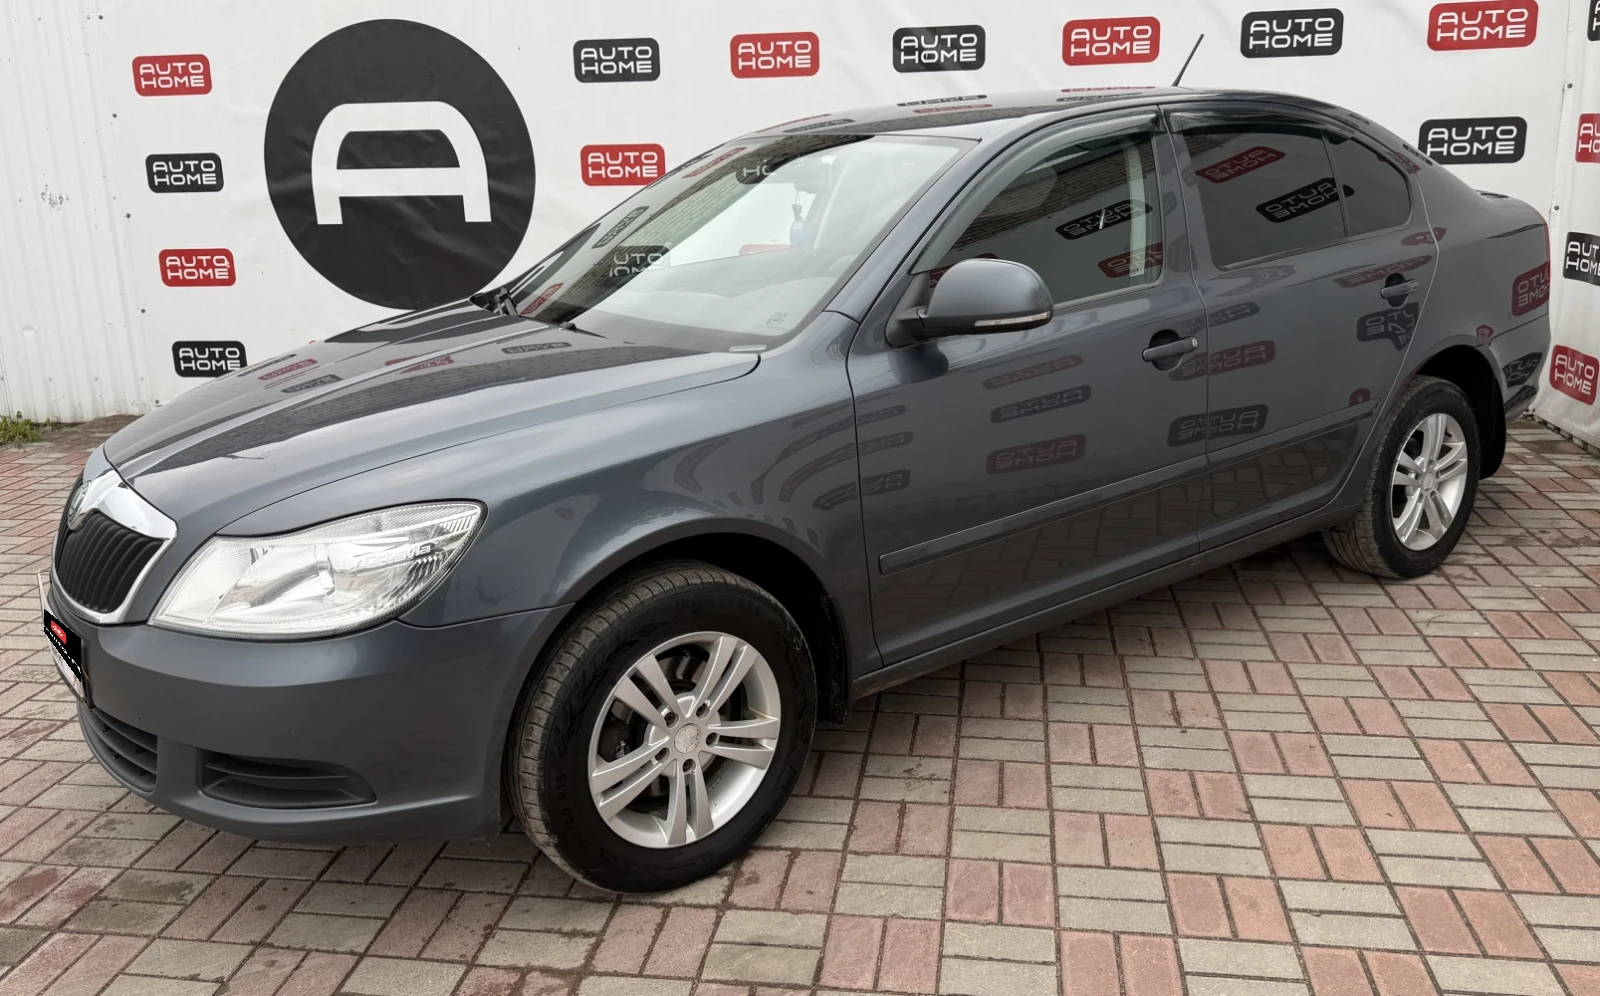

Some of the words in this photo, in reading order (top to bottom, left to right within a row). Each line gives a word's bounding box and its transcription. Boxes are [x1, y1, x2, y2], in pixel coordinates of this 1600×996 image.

[1438, 8, 1529, 26] AUTO
[1249, 17, 1335, 34] AUTO
[1436, 24, 1527, 42] HOME
[1070, 25, 1152, 42] AUTO
[737, 40, 812, 56] AUTO
[900, 33, 978, 50] AUTO
[1070, 40, 1151, 58] HOME
[1248, 33, 1334, 50] HOME
[580, 46, 653, 61] AUTO
[900, 48, 977, 65] HOME
[139, 62, 204, 75] AUTO
[581, 60, 653, 75] HOME
[738, 54, 812, 70] HOME
[140, 75, 205, 89] HOME
[1428, 125, 1518, 142] AUTO
[1426, 141, 1515, 156] HOME
[587, 151, 658, 165] AUTO
[152, 160, 216, 173] AUTO
[588, 165, 659, 179] HOME
[153, 173, 217, 186] HOME
[165, 255, 230, 268] AUTO
[613, 253, 663, 265] UTO
[167, 268, 229, 280] HOME
[178, 347, 241, 359] AUTO
[180, 359, 242, 371] HOME
[1555, 354, 1595, 380] AUTO
[1554, 368, 1592, 396] HOME
